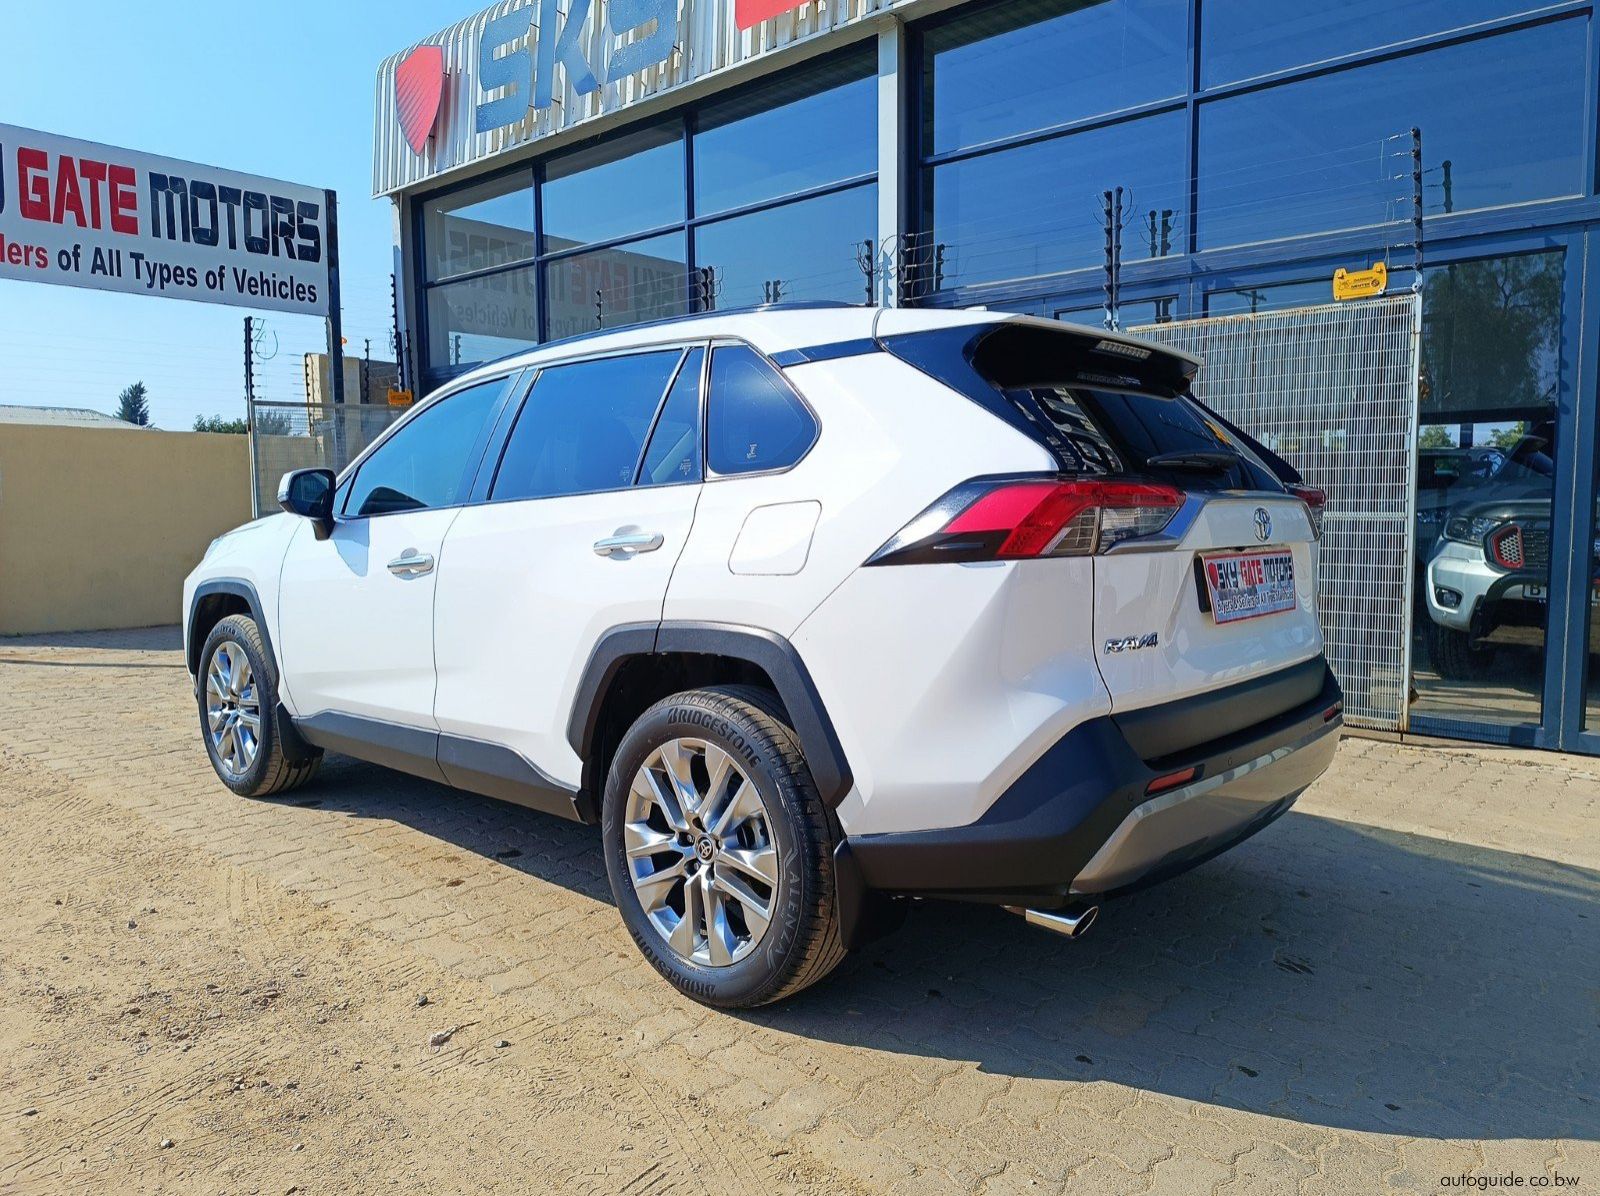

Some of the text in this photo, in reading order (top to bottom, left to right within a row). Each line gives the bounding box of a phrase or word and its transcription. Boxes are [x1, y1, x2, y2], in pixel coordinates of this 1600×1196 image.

[17, 146, 138, 235] GATE
[149, 171, 321, 263] MOTORS
[57, 243, 81, 273] of
[90, 246, 122, 278] All
[129, 251, 198, 290] Types
[205, 265, 226, 291] of
[233, 266, 318, 303] Vehicles
[1216, 556, 1293, 589] SKY GATE MOTORS
[1104, 632, 1158, 654] RAV4
[667, 707, 762, 768] BRIDGESTONE
[774, 870, 801, 955] ALENZA
